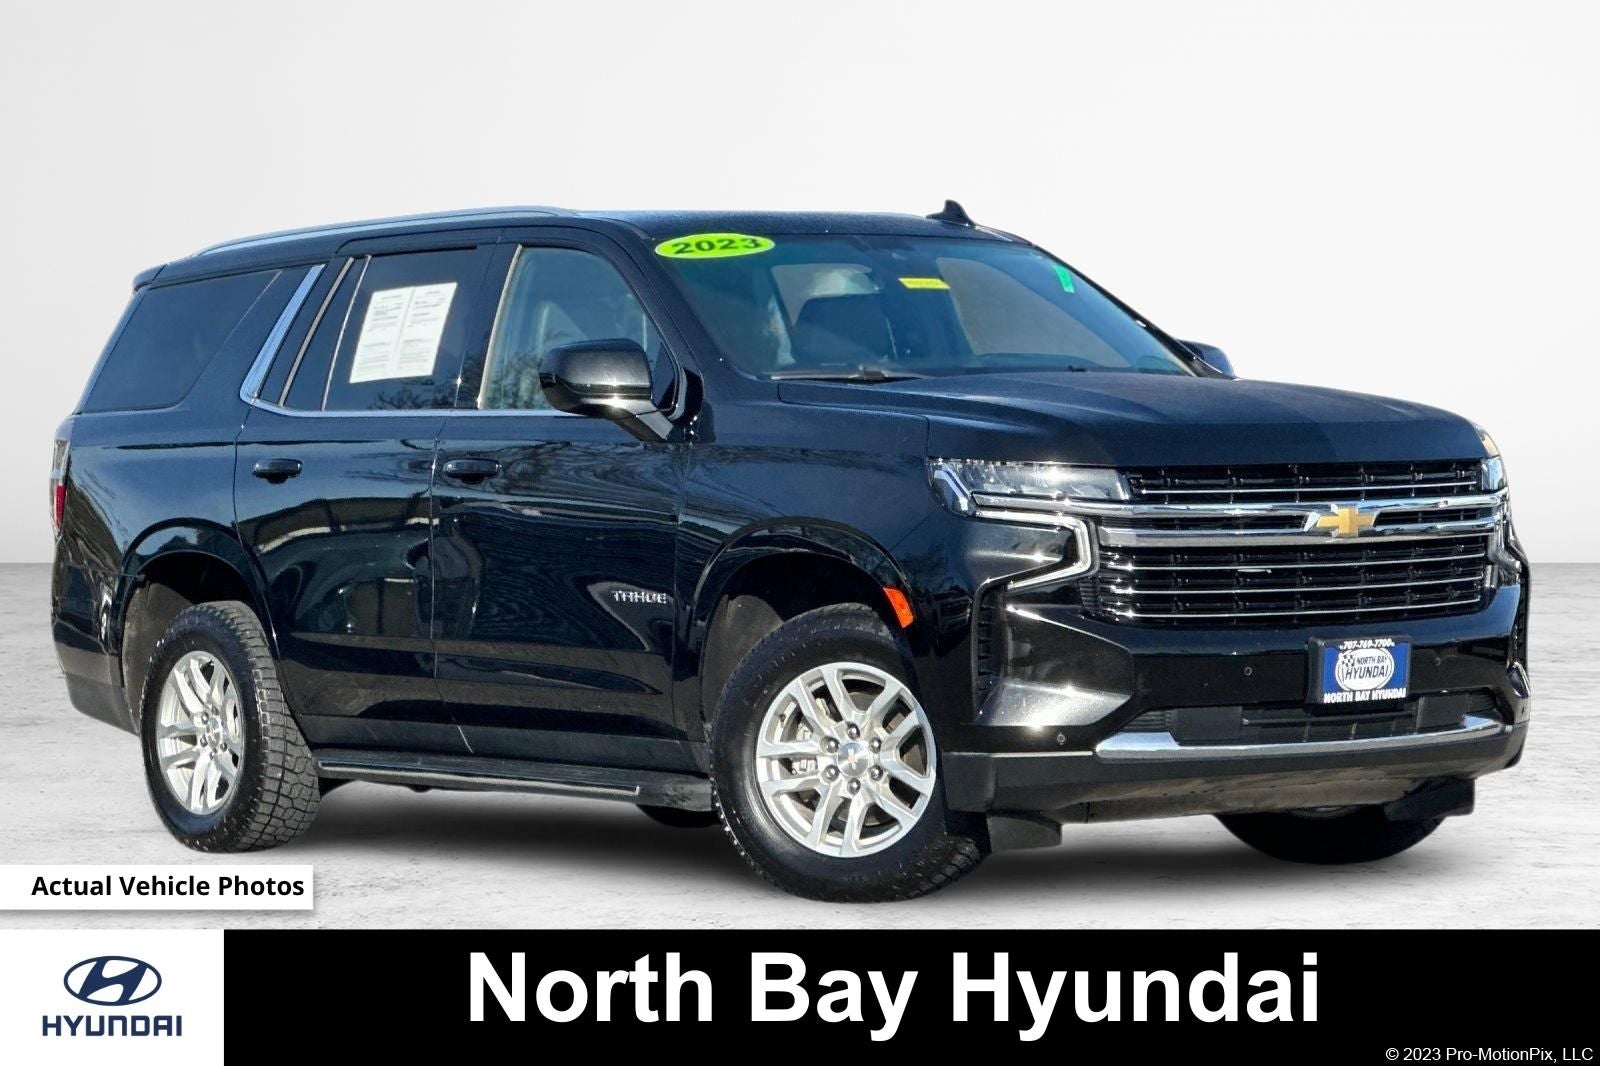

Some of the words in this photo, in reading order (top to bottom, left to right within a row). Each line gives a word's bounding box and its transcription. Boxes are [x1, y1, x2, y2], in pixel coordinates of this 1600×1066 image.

[671, 238, 762, 254] 2023
[1356, 656, 1376, 665] NORTH
[1345, 665, 1389, 680] HYUNDAI
[1323, 692, 1353, 703] NORTH
[1355, 691, 1370, 701] BAY
[1371, 688, 1407, 700] HYUNDAI
